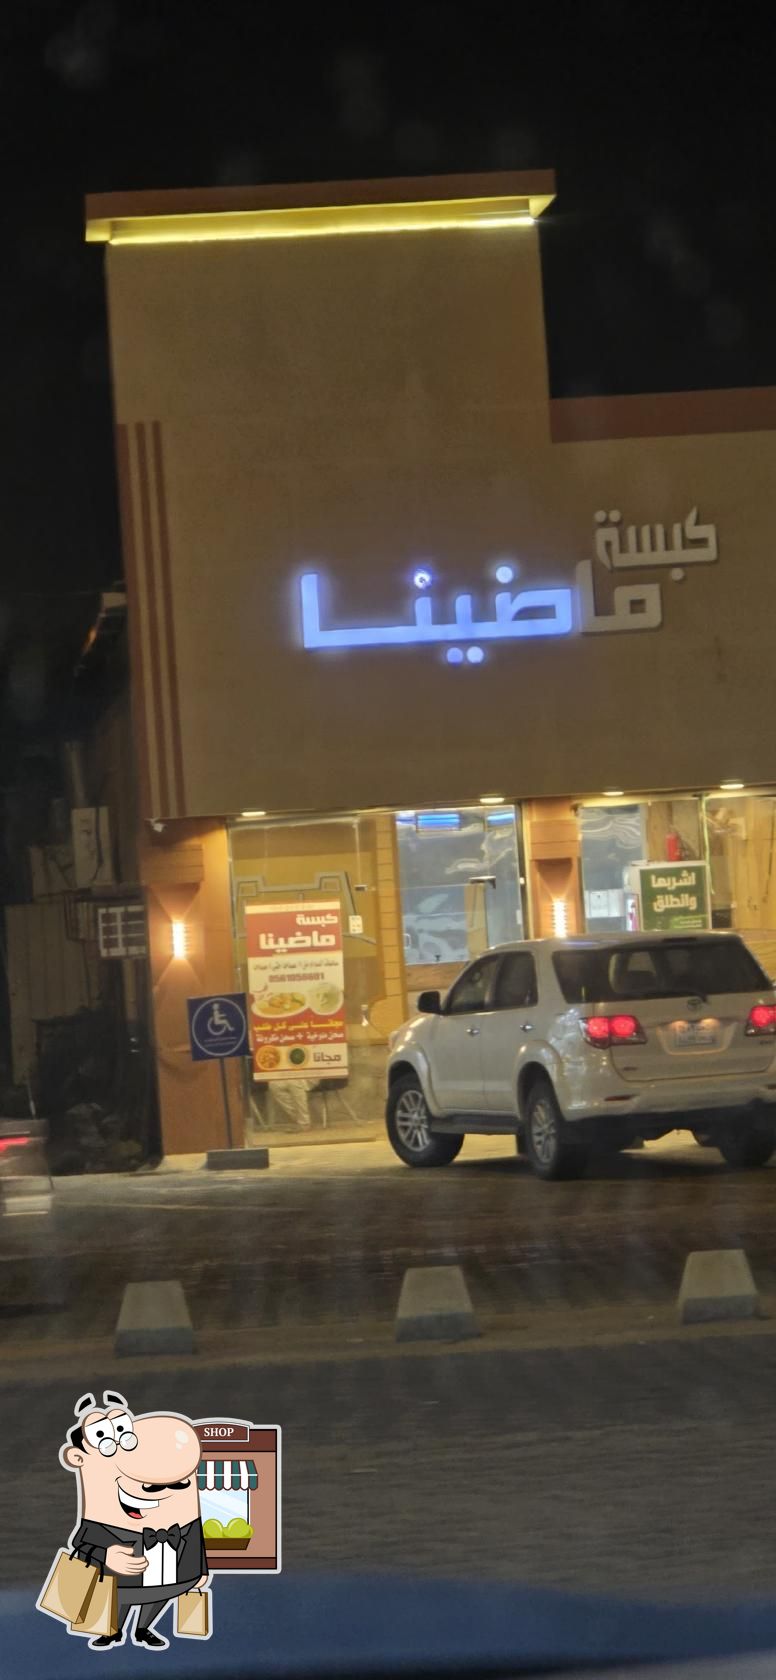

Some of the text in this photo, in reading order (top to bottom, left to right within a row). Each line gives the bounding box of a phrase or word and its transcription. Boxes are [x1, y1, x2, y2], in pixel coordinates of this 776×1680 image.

[595, 506, 718, 582] كبسة
[651, 870, 696, 890] اشربها
[653, 893, 697, 912] وانطلق
[296, 913, 338, 927] كبسة
[259, 931, 335, 953] ماضينا
[313, 1052, 341, 1065] مجانا
